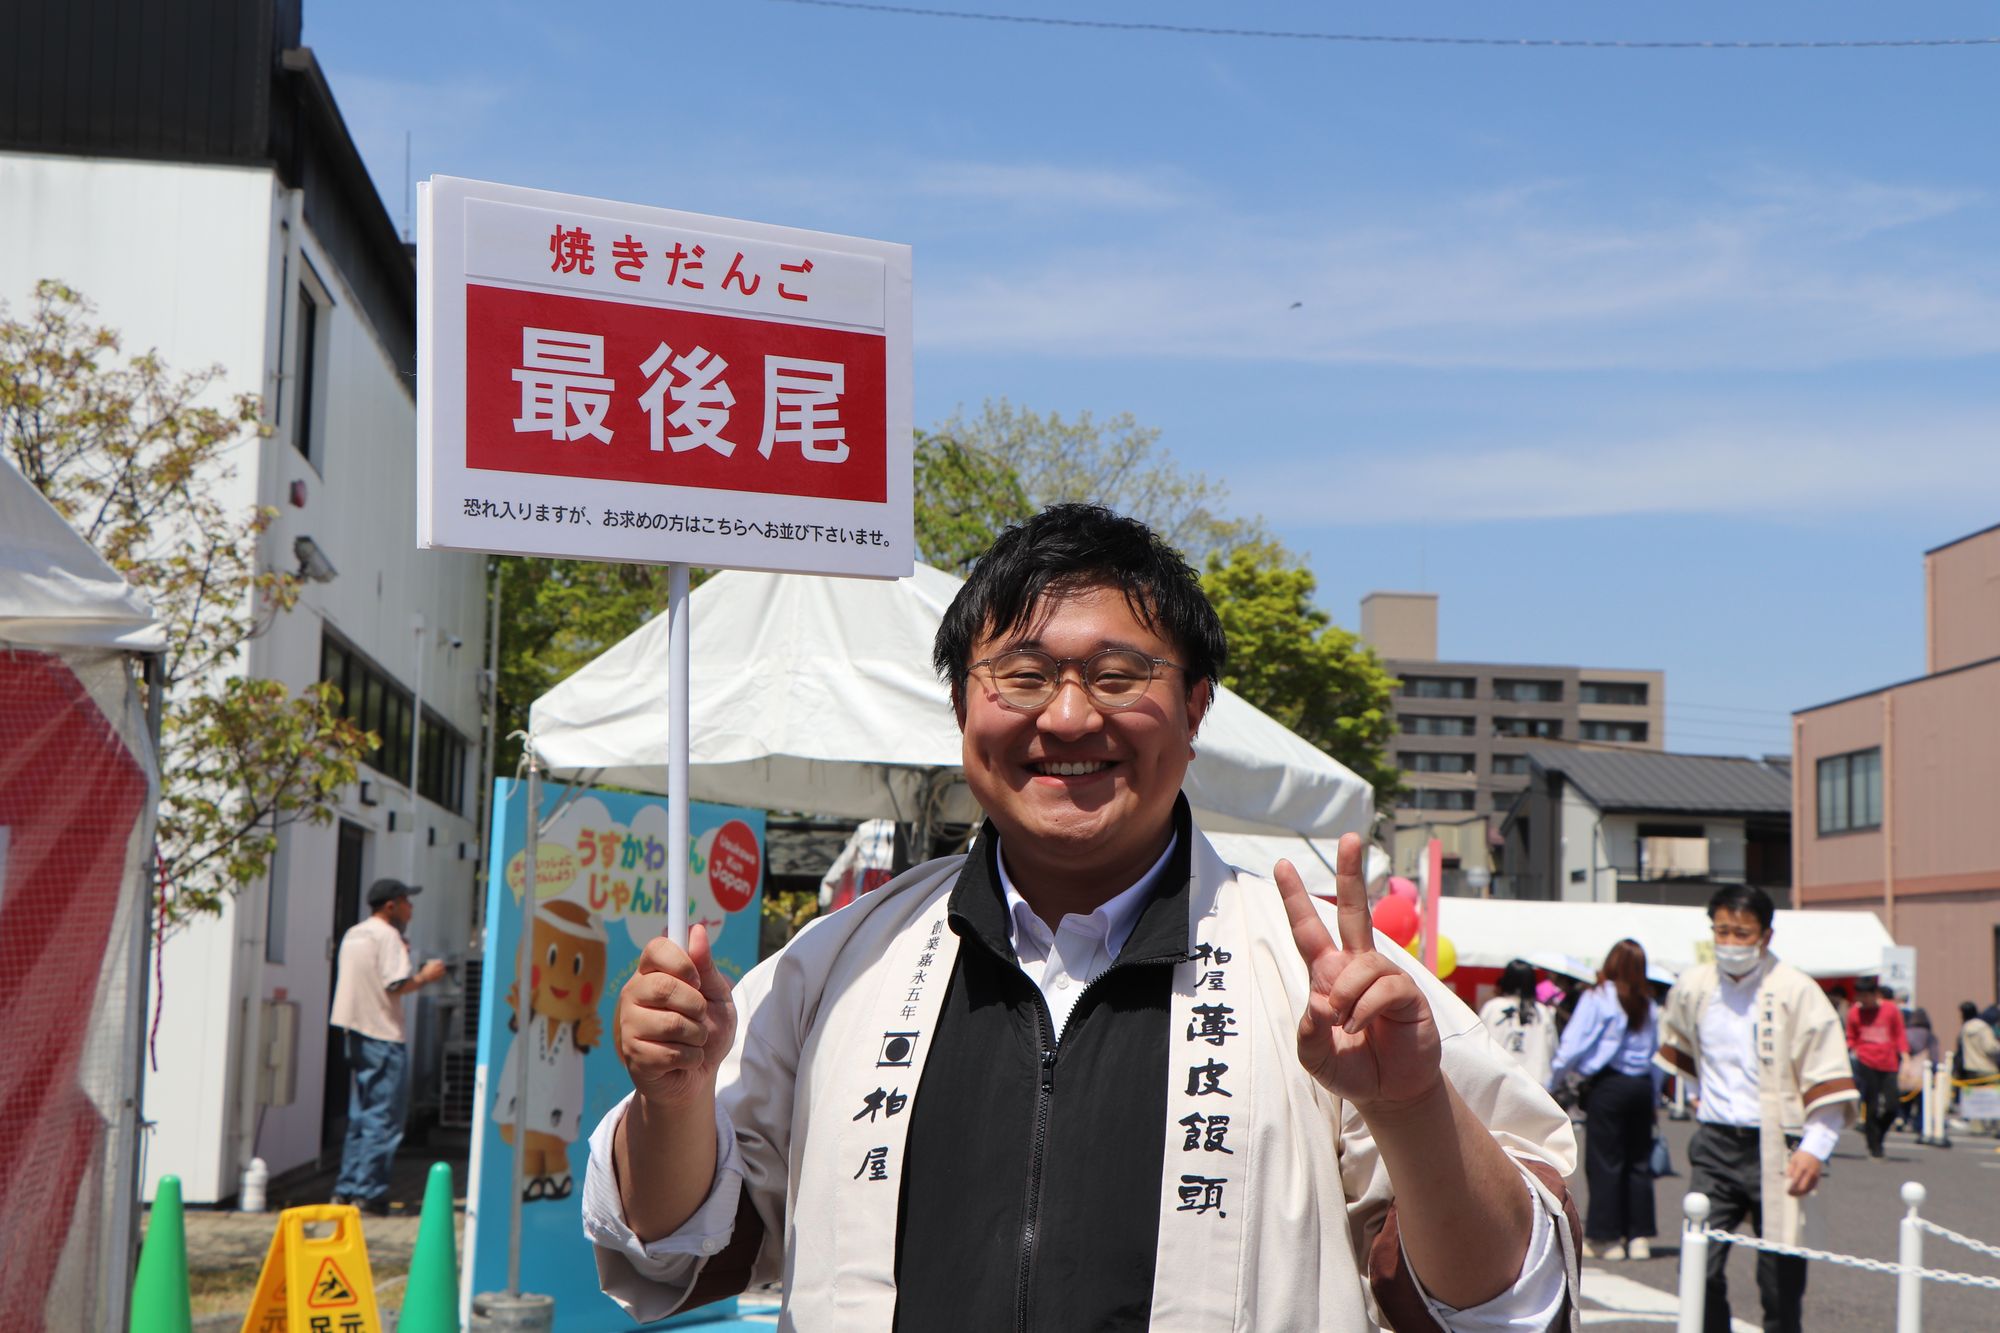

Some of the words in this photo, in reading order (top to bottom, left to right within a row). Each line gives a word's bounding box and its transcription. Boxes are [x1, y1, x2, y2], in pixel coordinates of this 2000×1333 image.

[549, 223, 814, 303] 焼きだんご
[511, 325, 851, 465] 最後尾
[463, 498, 891, 548] 恐れ入りますが、お求めの方はこちらへお並び下さいませ。
[577, 828, 706, 875] うすかわん
[711, 859, 751, 896] Japan
[900, 918, 945, 1021] 創業嘉永五年
[853, 1086, 908, 1181] 柏屋
